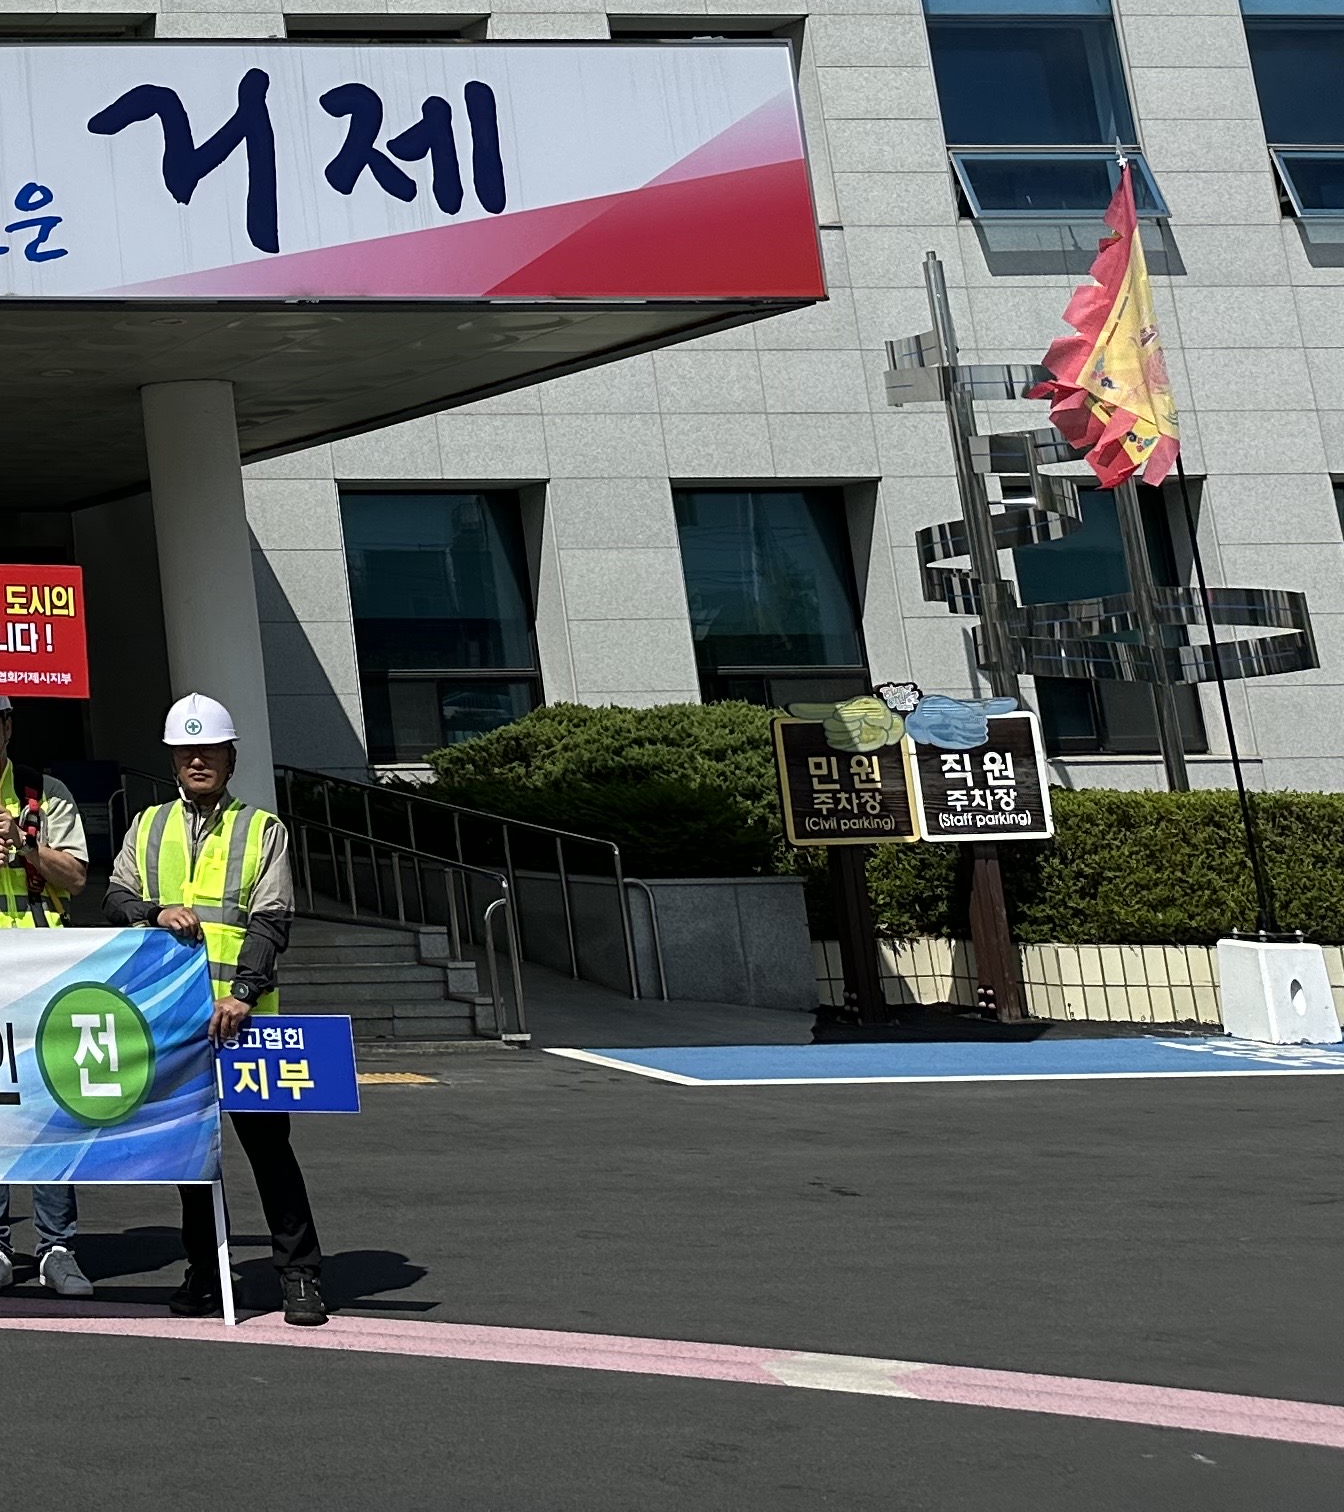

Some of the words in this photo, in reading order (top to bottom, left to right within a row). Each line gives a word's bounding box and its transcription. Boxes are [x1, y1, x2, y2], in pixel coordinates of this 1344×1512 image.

[88, 68, 506, 253] 거제
[5, 585, 75, 617] 도시의
[808, 755, 882, 789] 민원
[940, 751, 1016, 787] 직원
[813, 791, 883, 815] 주차장
[947, 788, 1018, 813] 주차장
[840, 815, 895, 831] parking)
[938, 812, 973, 828] (Staff
[976, 811, 1032, 828] parking)
[71, 1013, 122, 1098] 전
